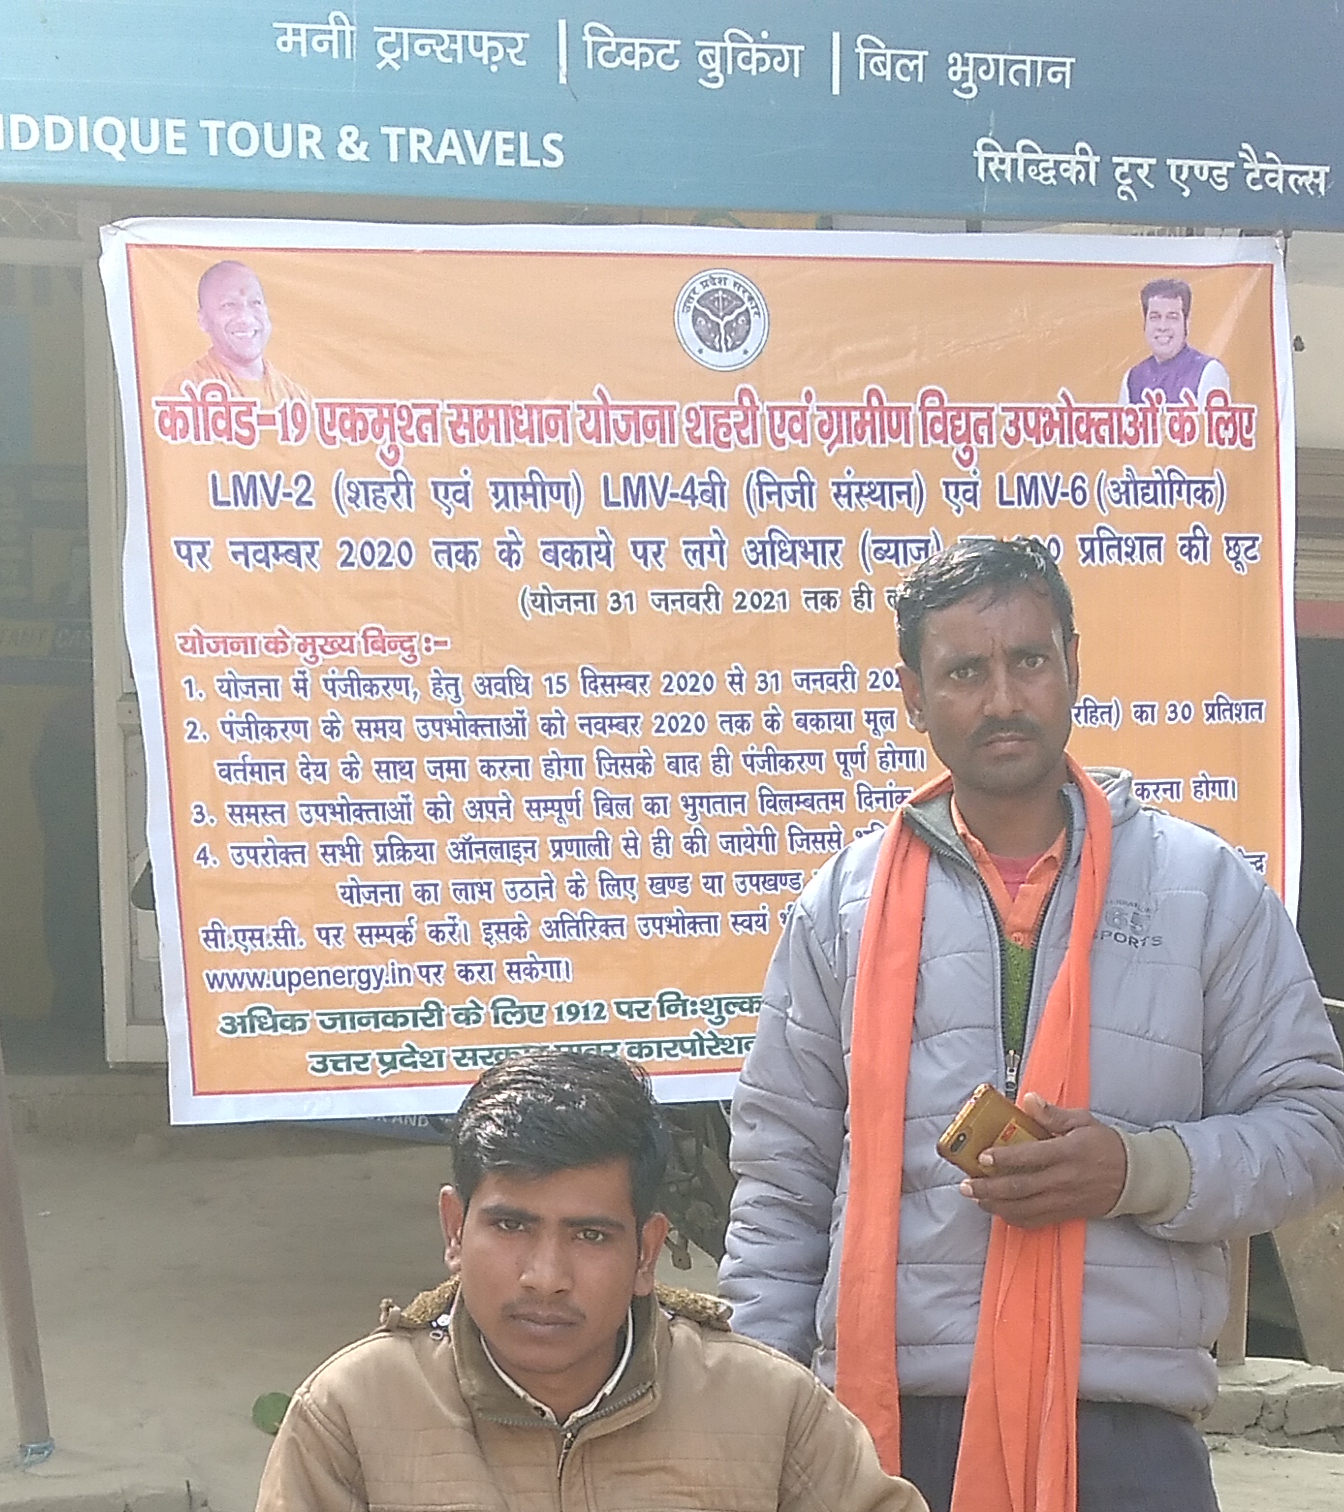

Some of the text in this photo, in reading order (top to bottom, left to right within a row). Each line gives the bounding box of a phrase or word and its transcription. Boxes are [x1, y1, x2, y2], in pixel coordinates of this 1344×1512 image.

[273, 11, 356, 61] मनी
[582, 21, 681, 72] टिकट
[695, 29, 804, 89] बुकिंग
[856, 34, 927, 83] बिल
[947, 53, 1076, 100] भुगतान
[199, 118, 326, 160] TOUR
[337, 123, 369, 162] &
[380, 124, 564, 168] TRAVELS
[1112, 156, 1157, 202] टूर
[1166, 158, 1235, 198] एण्ड
[157, 385, 1255, 466] कोविड-19 एकमुश्त समाधान योजना शहरी एवं ग्रामीण विद्युत उपभोक्ताओं के लिए
[211, 473, 313, 508] LMV-2
[334, 470, 414, 515] (शहरी
[432, 469, 471, 515] एवं
[489, 469, 582, 516] ग्रामीण)
[745, 469, 815, 516] (निजी
[832, 469, 924, 515] संस्थान)
[942, 469, 980, 515] एवं
[998, 474, 1087, 507] LMV-6
[174, 540, 211, 569] पर
[229, 540, 320, 569] नवम्बर
[339, 540, 413, 568] 2020
[432, 540, 479, 569] तक
[496, 529, 523, 568] के
[540, 528, 613, 569] बकाये
[630, 540, 666, 569] पर
[682, 530, 726, 568] लगे
[744, 528, 843, 568] अधिभार
[1078, 525, 1164, 564] प्रतिशत
[1178, 524, 1210, 563] की
[1224, 535, 1260, 573] छूट
[520, 584, 596, 617] (योजना
[609, 592, 634, 612] 31
[650, 583, 721, 613] जनवरी
[734, 591, 787, 611] 2021
[802, 590, 839, 611] तक
[851, 581, 873, 611] ही
[178, 629, 257, 655] योजना
[263, 629, 290, 654] के
[296, 635, 356, 665] मुख्य
[361, 626, 418, 664] बिन्दु
[184, 663, 857, 704] 1. योजना में पंजीकरण, हेतु अवधि 15 दिसम्बर 2020 से 31 जनवरी
[186, 720, 207, 740] 2.
[220, 712, 309, 741] पंजीकरण
[321, 711, 342, 740] के
[355, 719, 403, 739] समय
[416, 709, 527, 739] उपभोक्ताओं
[539, 709, 566, 737] को
[577, 715, 641, 736] नवम्बर
[654, 714, 706, 734] 2020
[718, 713, 752, 733] तक
[763, 705, 782, 733] के
[794, 711, 853, 732] बकाया
[863, 710, 896, 737] मूल
[1132, 704, 1156, 723] का
[1167, 703, 1192, 722] 30
[1203, 694, 1264, 722] प्रतिशत
[315, 926, 344, 946] पर
[356, 918, 415, 946] सम्पर्क
[482, 913, 529, 943] इसके
[541, 911, 626, 940] अतिरिक्त
[637, 908, 720, 937] उपभोक्ता
[730, 906, 768, 933] स्वयं
[1094, 929, 1163, 949] PORTS
[205, 961, 412, 993] www.upenergy.in
[417, 964, 444, 984] पर
[456, 962, 494, 982] करा
[219, 1005, 310, 1035] अधिक
[317, 1000, 445, 1031] जानकारी
[452, 999, 483, 1026] के
[492, 997, 546, 1026] लिए
[554, 1002, 607, 1022] 1912
[613, 1000, 653, 1020] पर
